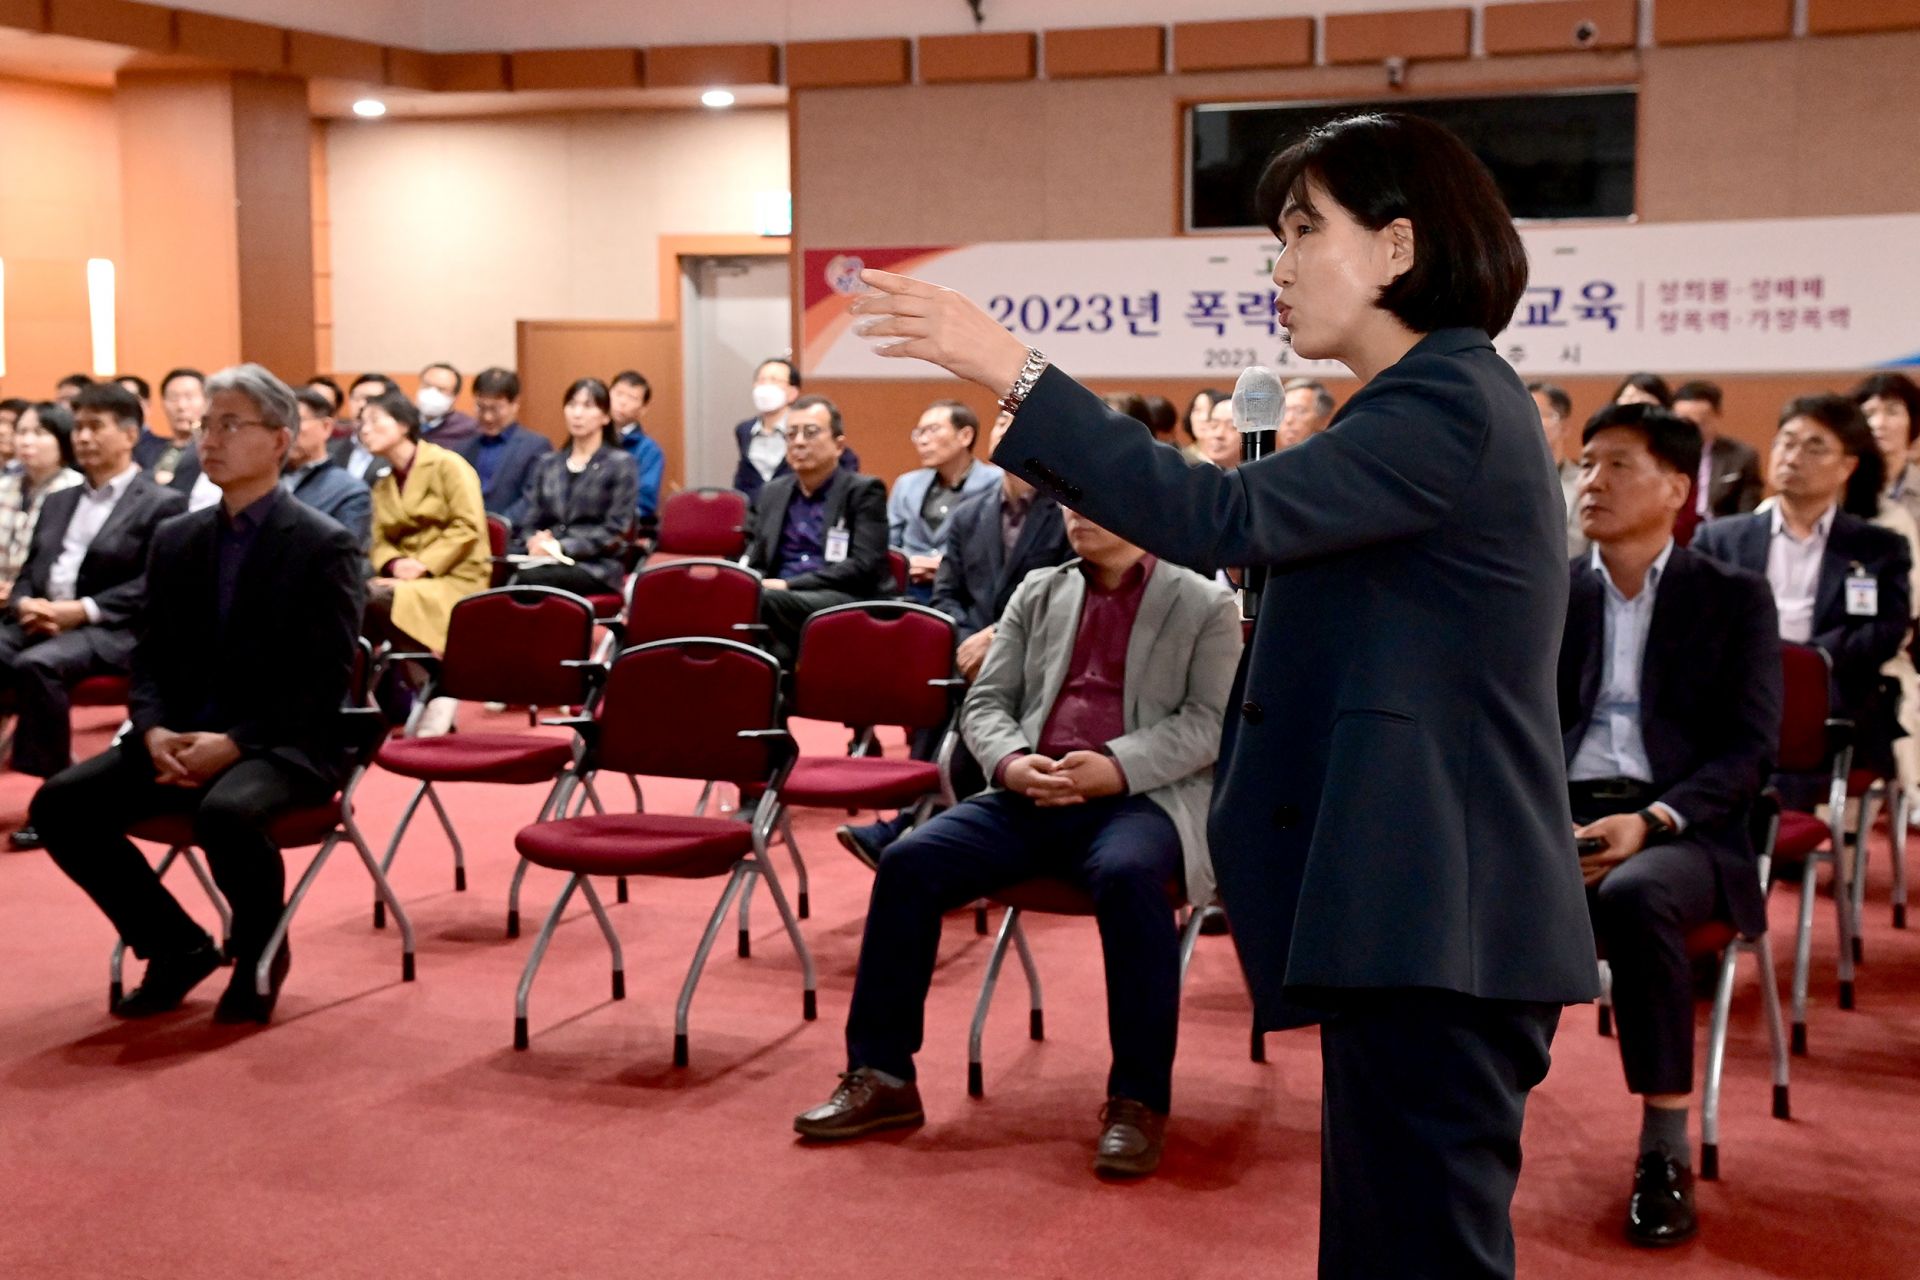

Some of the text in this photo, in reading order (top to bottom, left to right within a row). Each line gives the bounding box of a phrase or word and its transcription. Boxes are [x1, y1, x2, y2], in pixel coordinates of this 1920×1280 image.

[989, 291, 1161, 336] 2023년
[1517, 281, 1624, 331] 교육
[1658, 307, 1850, 333] 성폭력·가정폭력
